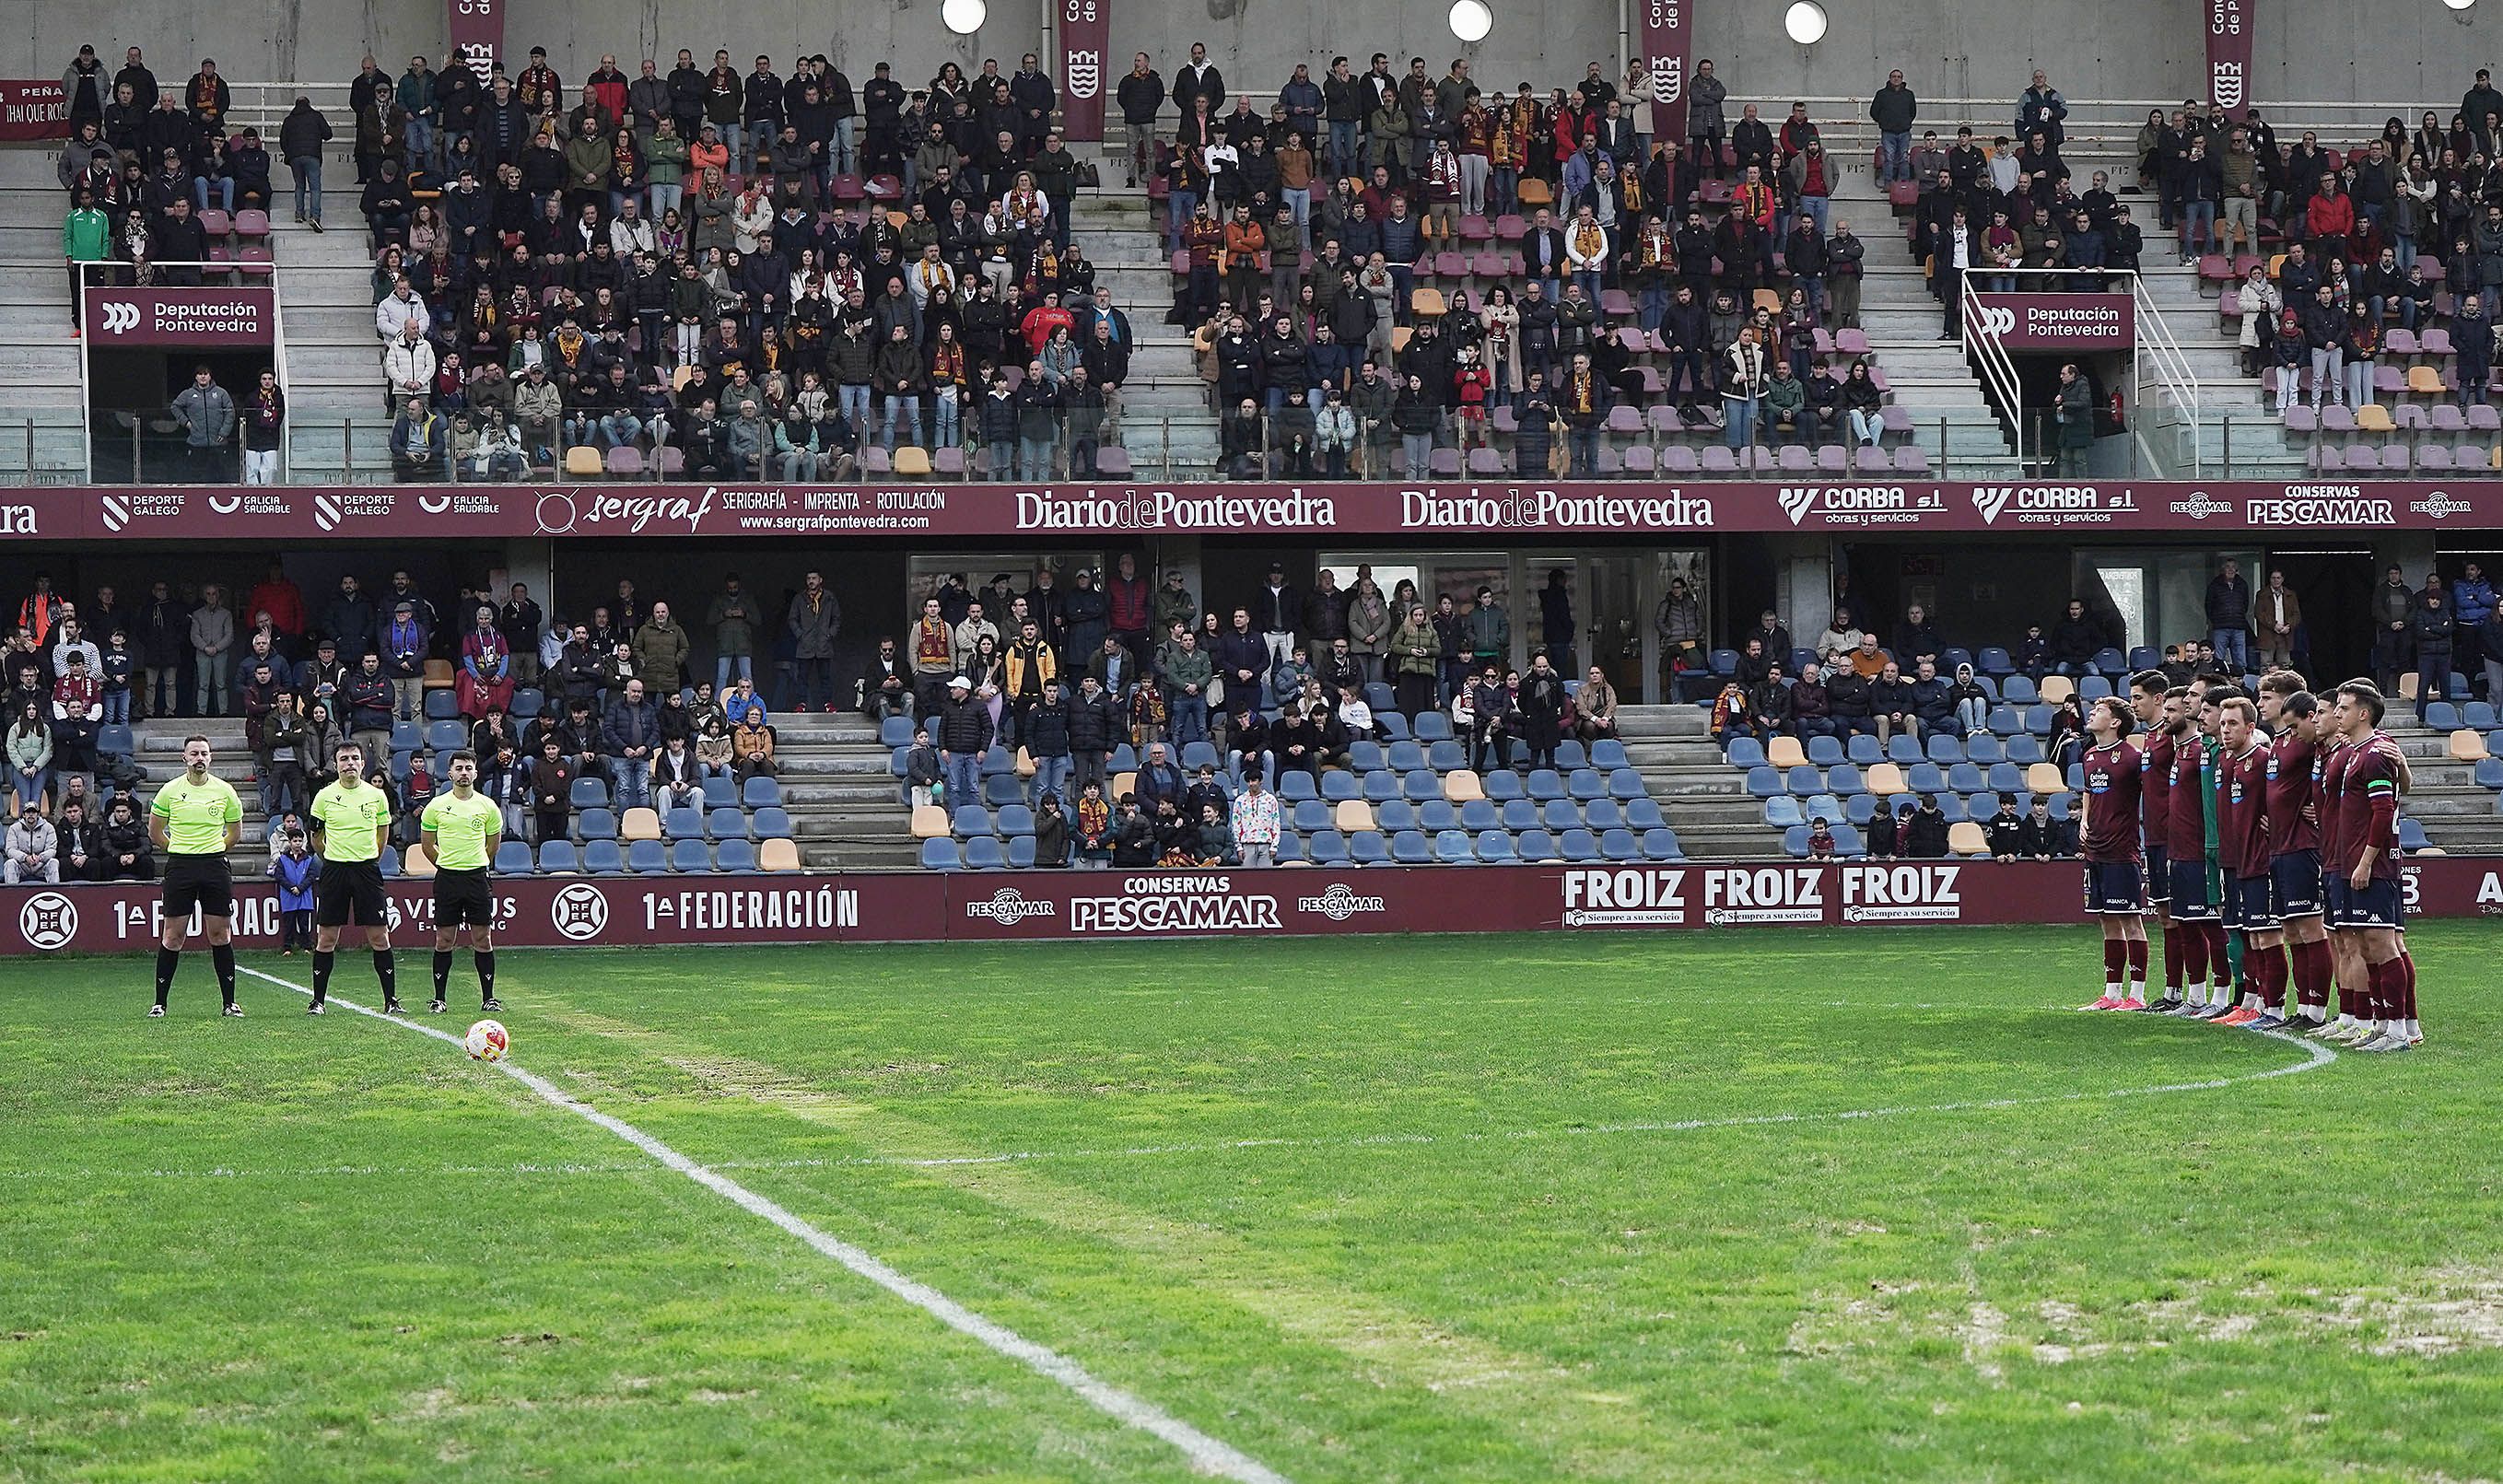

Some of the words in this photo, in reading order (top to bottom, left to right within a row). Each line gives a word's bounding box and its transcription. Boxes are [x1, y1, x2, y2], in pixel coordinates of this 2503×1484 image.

[2228, 0, 2240, 10] P
[1665, 7, 1678, 29] de
[2228, 14, 2240, 35] de
[21, 87, 64, 97] PEÑA
[26, 103, 45, 123] QUE
[155, 302, 257, 320] Deputación
[2028, 307, 2119, 323] Deputación
[155, 319, 257, 333] Pontevedra
[2028, 323, 2120, 336] Pontevedra
[1825, 487, 1905, 508] CORBA
[2018, 487, 2097, 508] CORBA
[2285, 485, 2360, 497] CONSERVAS
[133, 495, 184, 505] DEPORTE
[244, 496, 280, 505] GALICIA
[344, 495, 395, 505] DEPORTE
[454, 496, 490, 505] GALICIA
[722, 489, 787, 509] SERIGRAFÍA
[804, 492, 860, 509] IMPRENTA
[877, 489, 945, 509] ROTULACIÓN
[133, 506, 180, 516] GALEGO
[244, 504, 290, 514] SAUDABLE
[344, 506, 391, 516] GALEGO
[454, 504, 500, 514] SAUDABLE
[582, 486, 717, 533] sergraf
[2170, 501, 2233, 513] PESCAMAR
[2246, 499, 2397, 524] PESCAMAR
[2410, 501, 2472, 512] PESCAMAR
[740, 514, 929, 532] www.sergrafpontevedra.com
[1825, 513, 1859, 523] obras
[1861, 515, 1868, 526] y
[1870, 513, 1920, 523] servicios
[2018, 513, 2051, 523] obras
[2053, 514, 2061, 525] y
[2063, 512, 2111, 522] servicios
[1124, 877, 1230, 894] CONSERVAS
[1566, 870, 1686, 907] FROIZ
[1705, 869, 1824, 906] FROIZ
[1843, 866, 1961, 904] FROIZ
[571, 903, 589, 911] RF
[680, 883, 859, 929] FEDERACIÓN
[966, 900, 1055, 917] PESCAMAR
[1298, 896, 1386, 912] PESCAMAR
[40, 911, 58, 919] RF
[571, 912, 589, 920] EF
[1070, 894, 1283, 931] PESCAMAR
[1587, 912, 1625, 923] Siempre
[1645, 913, 1680, 921] servicio
[1727, 911, 1765, 922] Siempre
[1784, 911, 1819, 919] servicio
[1866, 909, 1901, 918] Siempre
[40, 921, 58, 929] EF
